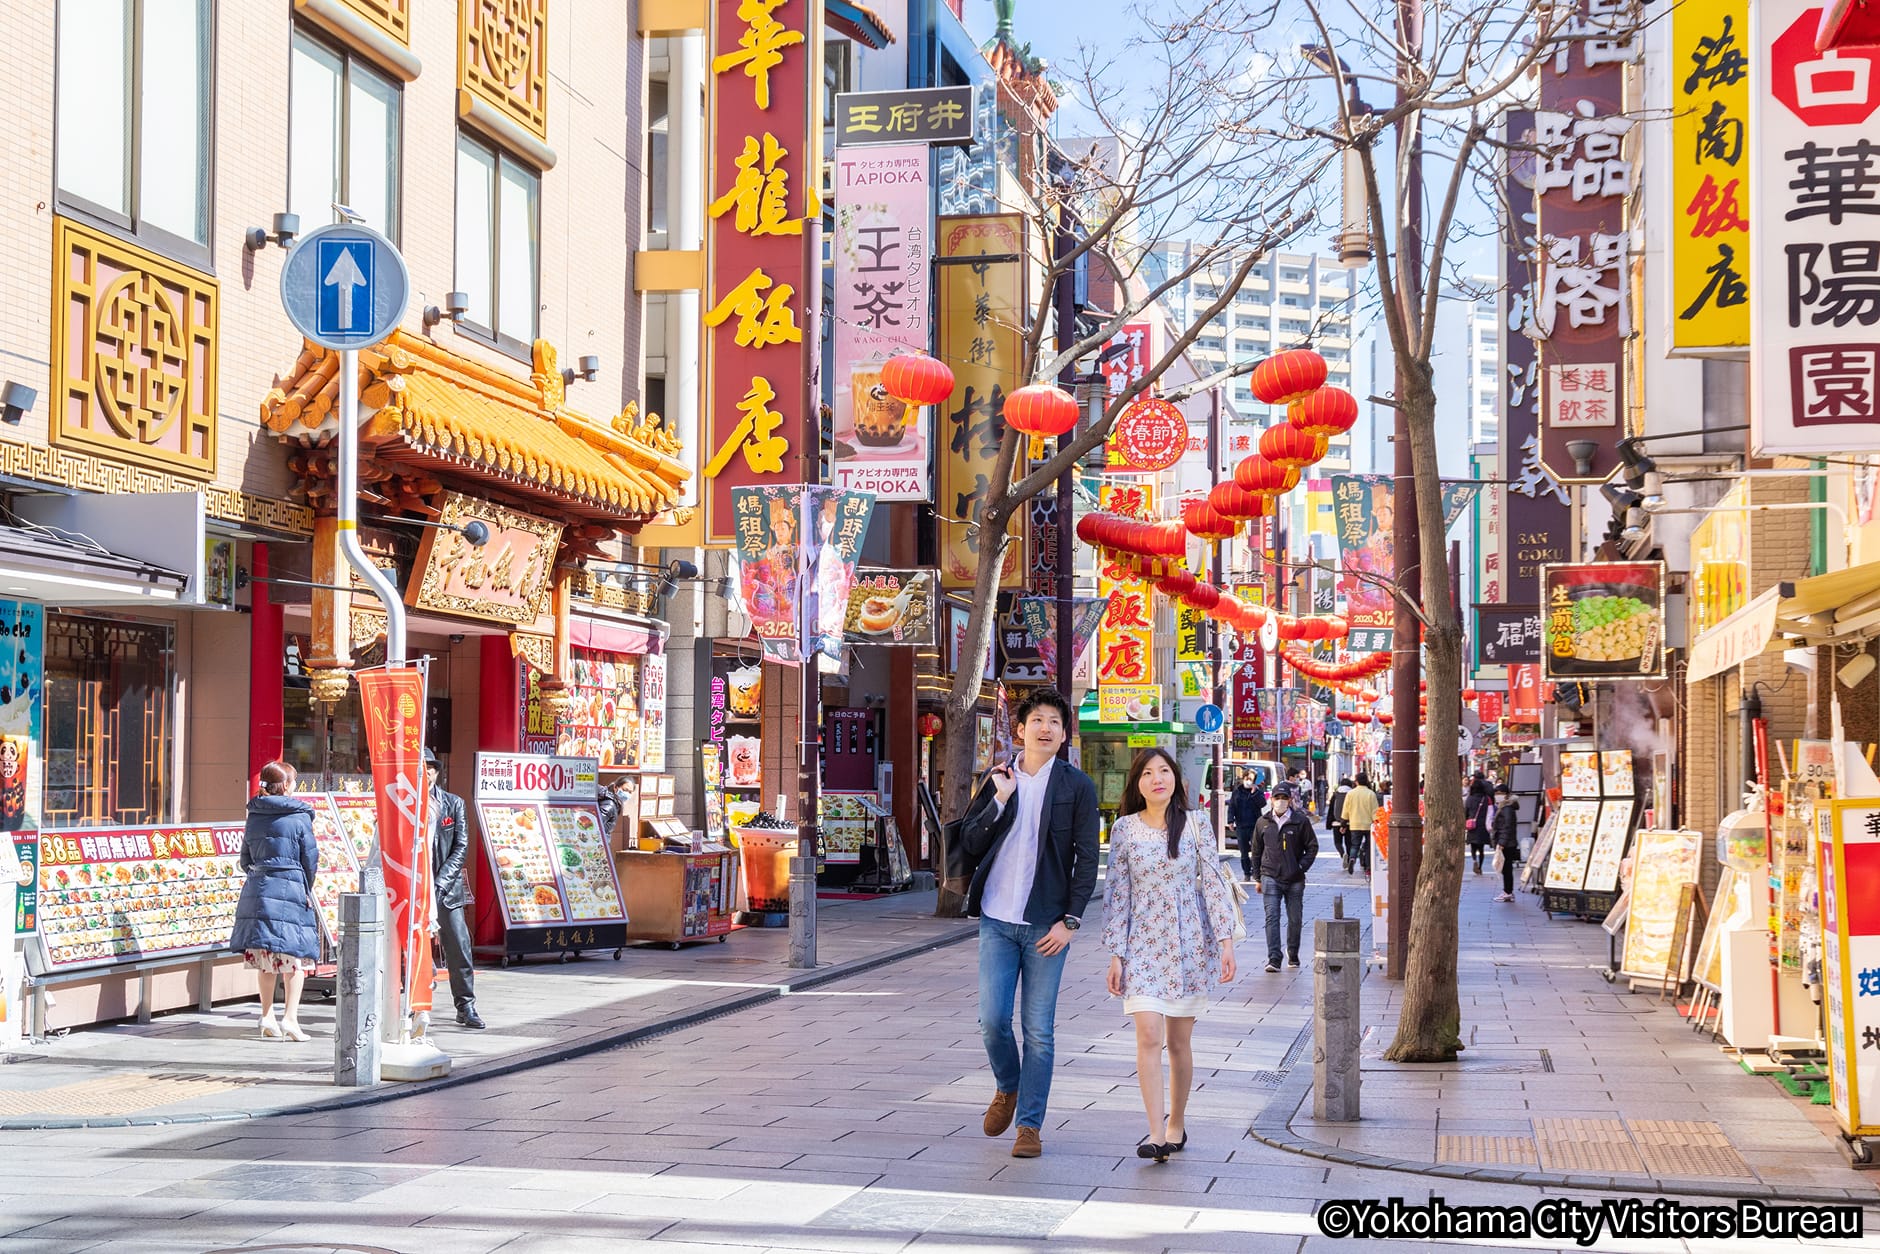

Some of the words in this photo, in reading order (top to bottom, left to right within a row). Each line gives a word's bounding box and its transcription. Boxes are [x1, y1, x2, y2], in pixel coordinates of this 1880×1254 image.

[846, 100, 965, 134] 王府井
[841, 162, 923, 187] TAPIOKA
[1680, 15, 1750, 321] 海南飯店
[703, 0, 821, 480] 華龍飯店
[907, 226, 922, 330] 台湾タピオカ
[1784, 138, 1880, 428] 華陽園
[854, 335, 882, 344] WANG
[1558, 369, 1607, 393] 香港
[1558, 399, 1607, 421] 飲茶
[1132, 425, 1171, 441] 春節
[737, 495, 767, 559] 媽祖祭
[1336, 481, 1367, 547] 媽祖祭
[1517, 531, 1549, 545] SAN
[1517, 548, 1564, 561] GOKU
[1024, 601, 1044, 639] 媽祖祭
[1354, 614, 1373, 623] 2020
[1550, 584, 1576, 658] 生煎包
[1352, 632, 1394, 650] 翠香
[1104, 696, 1127, 705] 1680
[481, 779, 513, 791] 食べ放題
[80, 834, 153, 861] 時間無制限
[150, 830, 216, 860] 食べ放題
